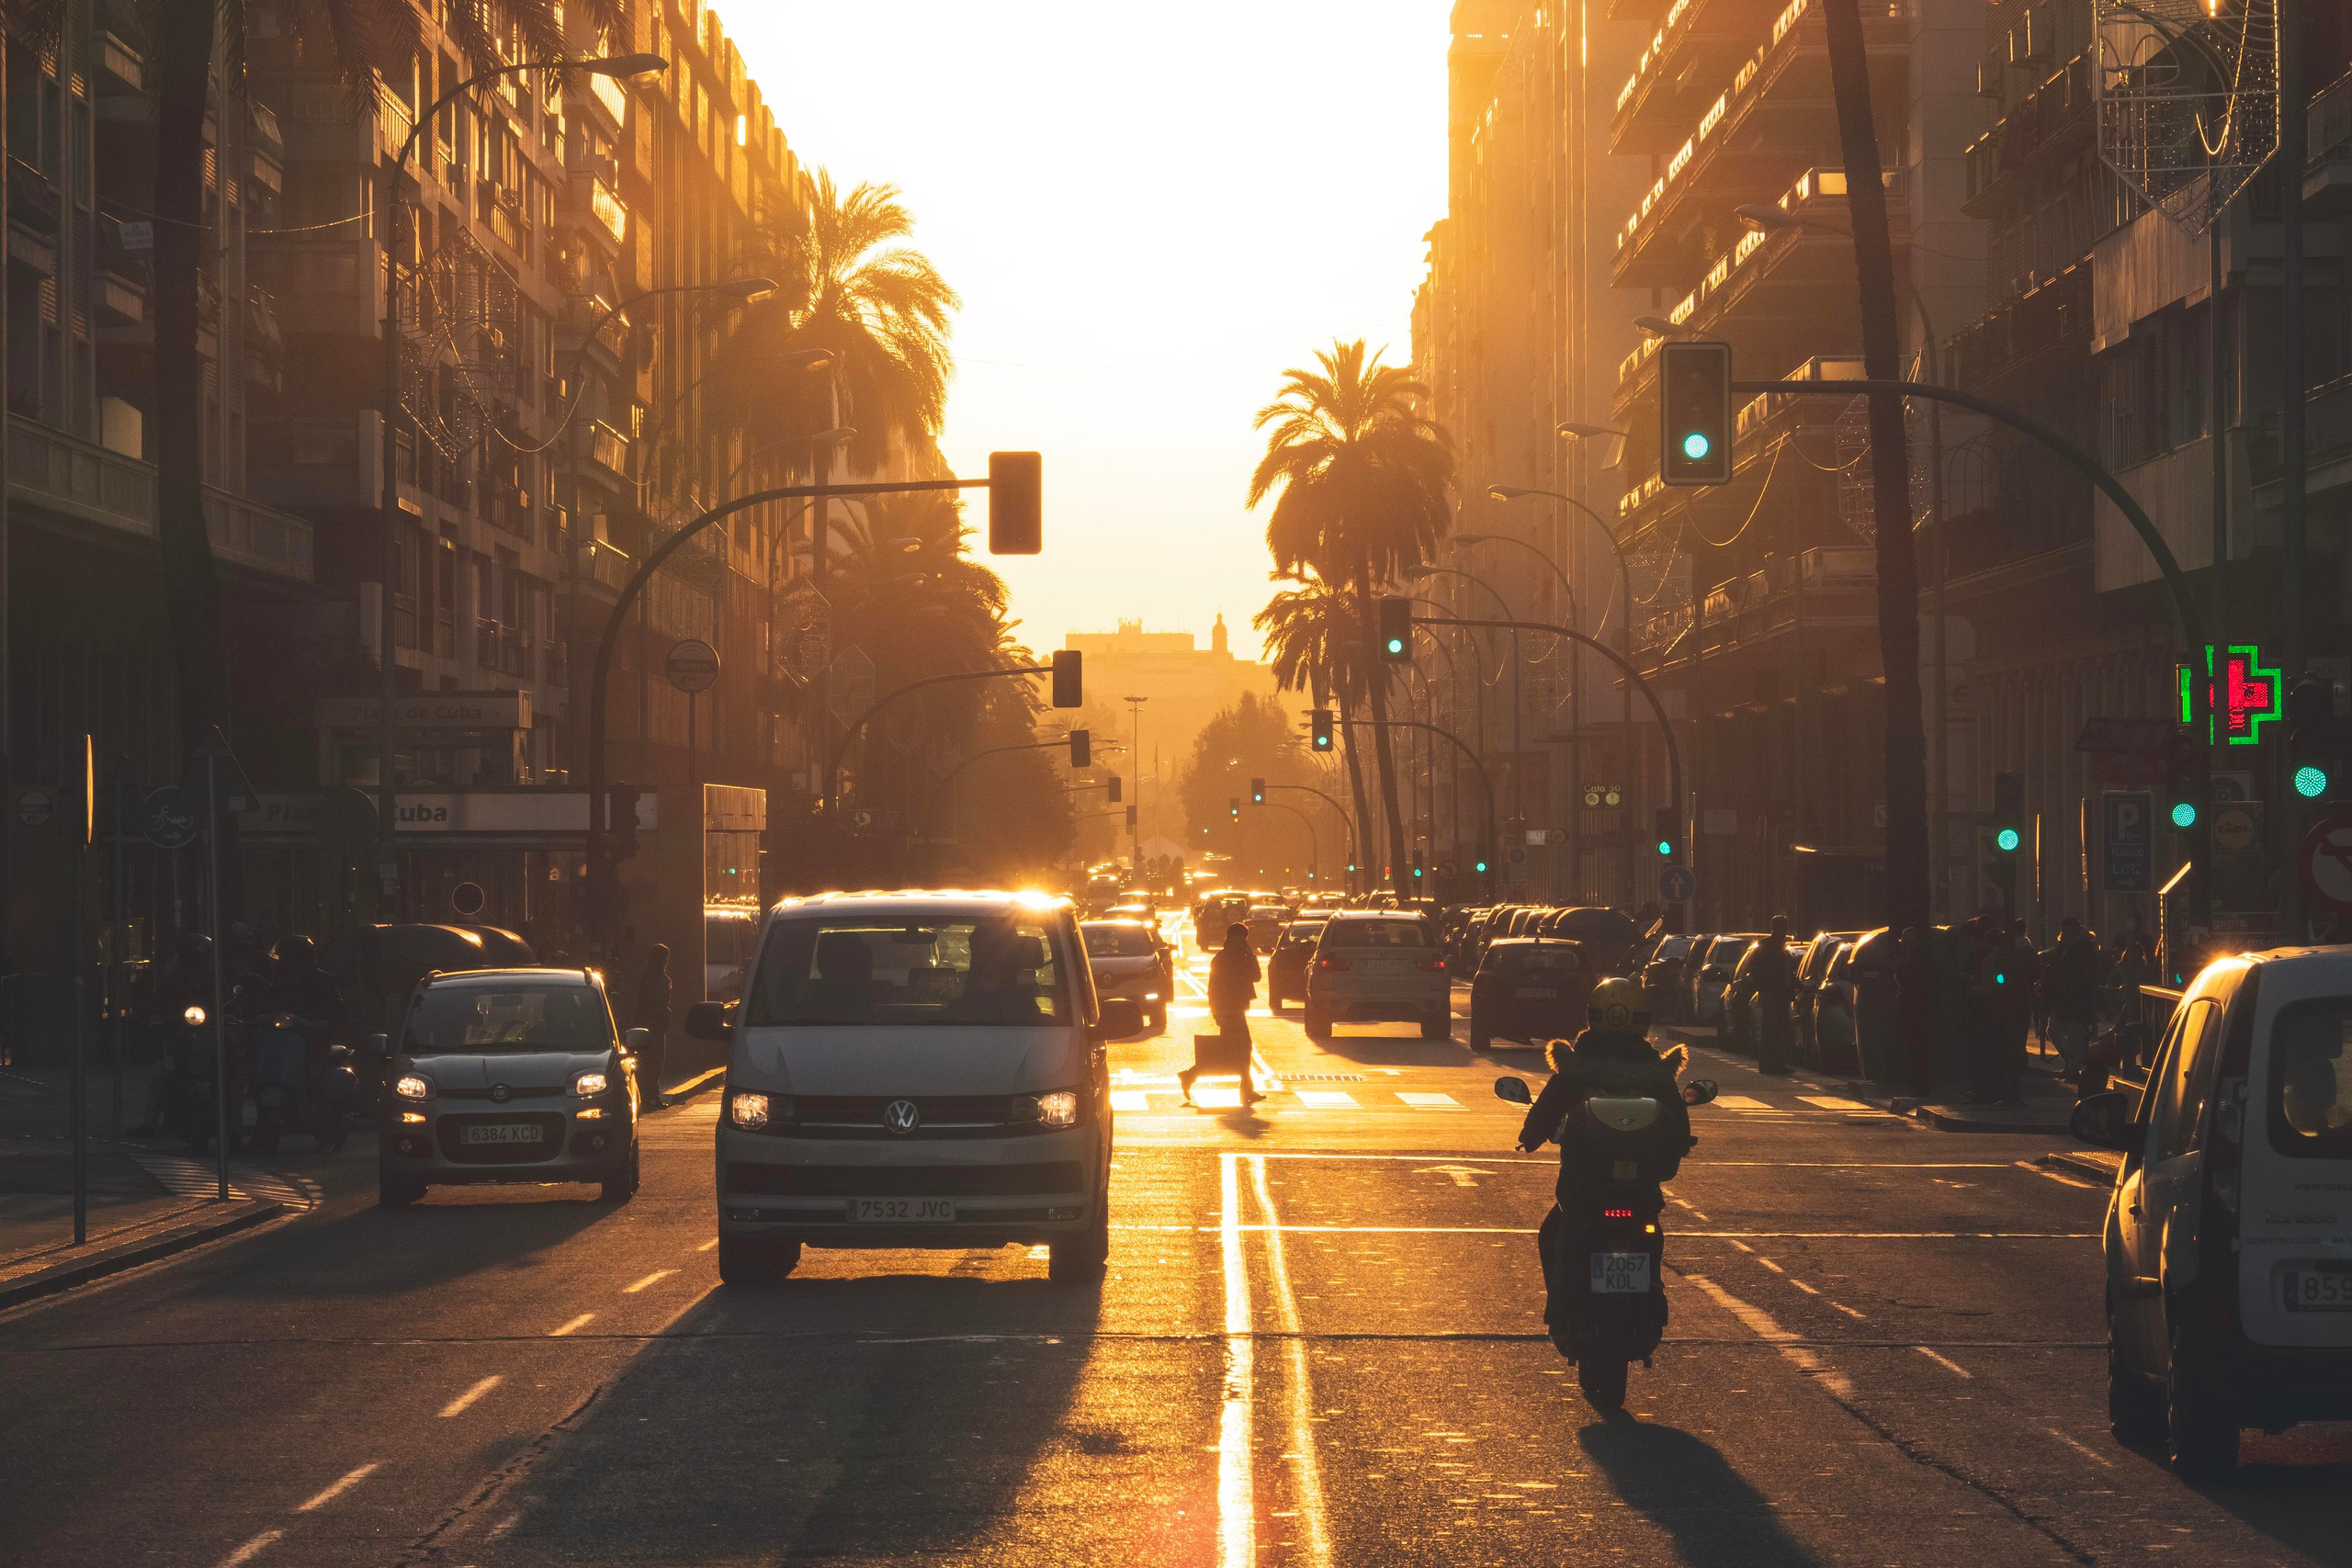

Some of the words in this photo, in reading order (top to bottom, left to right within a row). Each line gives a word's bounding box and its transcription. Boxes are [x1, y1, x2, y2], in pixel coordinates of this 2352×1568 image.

[675, 661, 709, 671] Metro
[353, 706, 401, 719] Pla
[406, 706, 428, 719] de
[435, 706, 482, 720] Cuba
[267, 804, 320, 822] Plaz
[394, 804, 447, 822] uba
[2118, 803, 2140, 840] P
[471, 1127, 507, 1142] 6384
[512, 1126, 539, 1141] KCD
[861, 1201, 909, 1218] 7532
[915, 1201, 951, 1218] JVC
[1605, 1256, 1646, 1273] 2067
[1605, 1273, 1636, 1291] KDL
[2303, 1276, 2352, 1301] 859
